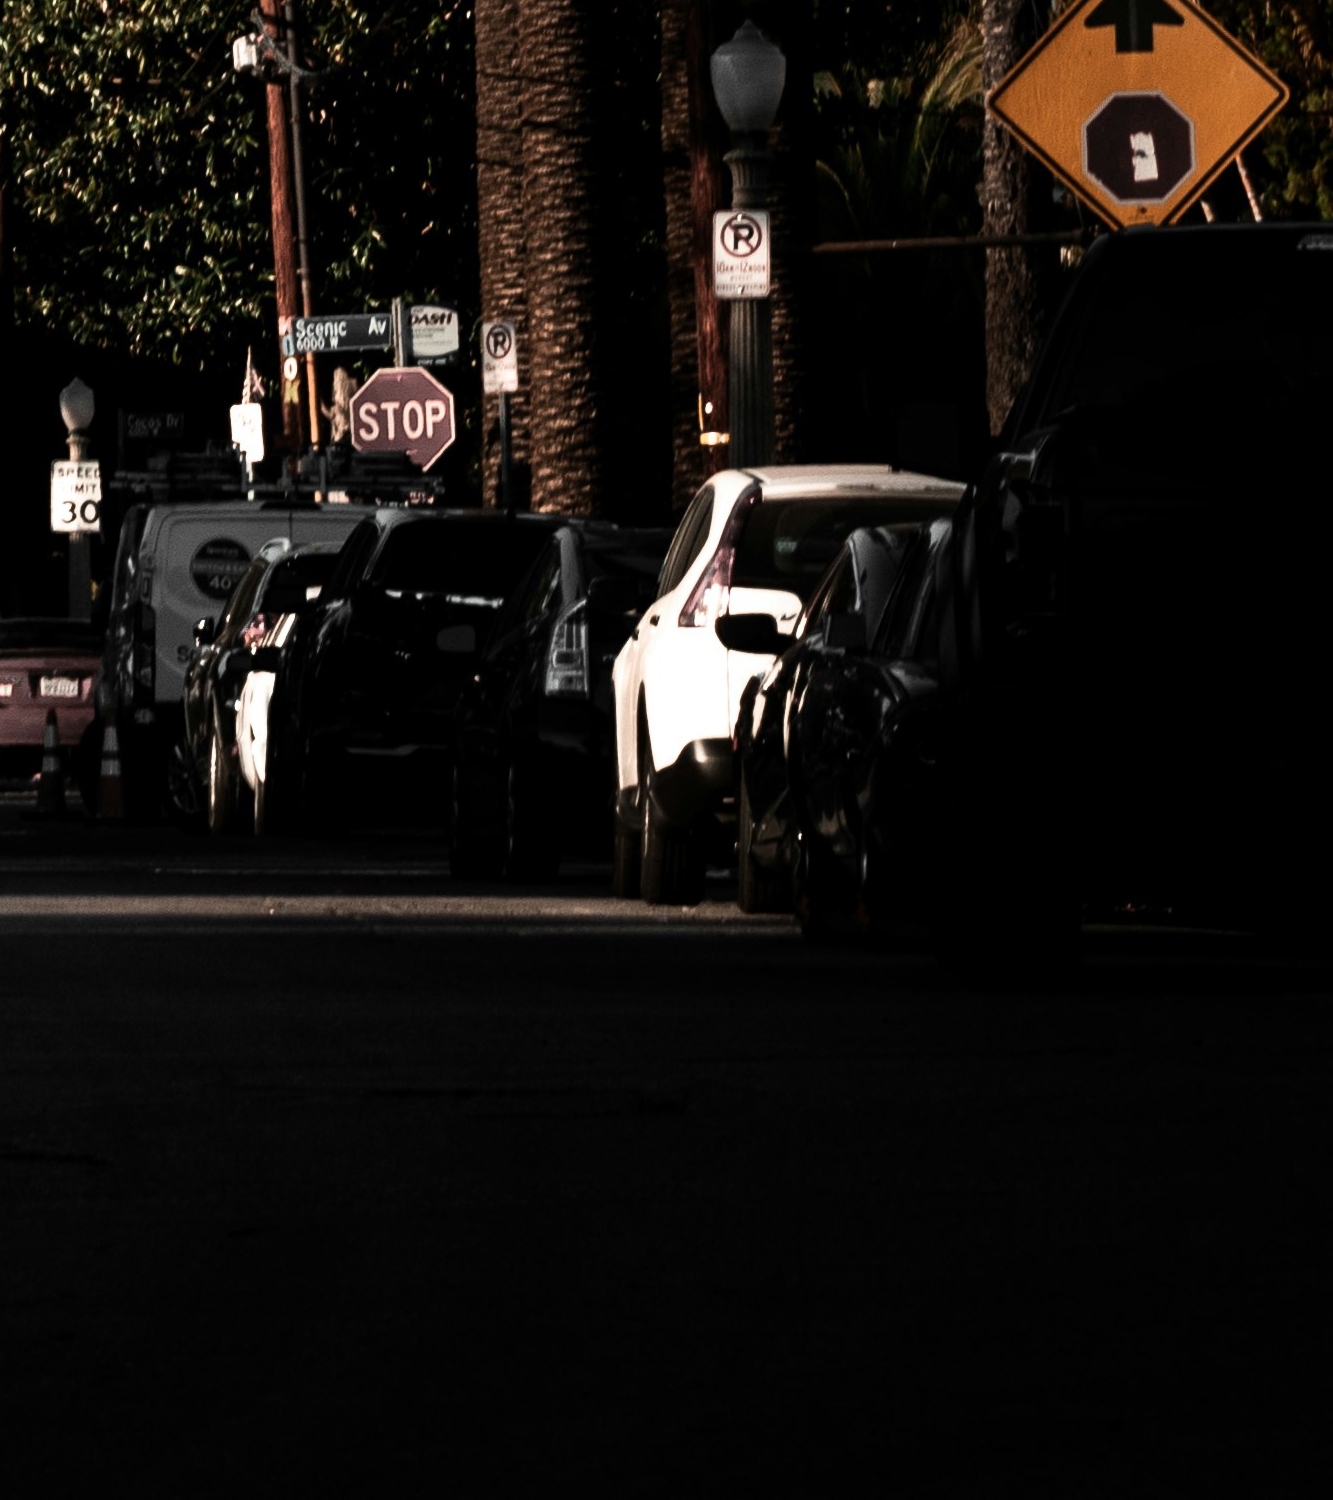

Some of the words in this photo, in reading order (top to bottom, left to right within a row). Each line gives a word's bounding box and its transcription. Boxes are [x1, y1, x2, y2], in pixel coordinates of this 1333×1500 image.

[295, 319, 347, 338] Scenic
[367, 315, 387, 336] Av
[296, 335, 325, 351] 6000
[329, 336, 339, 349] W
[359, 399, 446, 442] STOP
[57, 466, 100, 479] SPEED
[62, 499, 100, 524] 30
